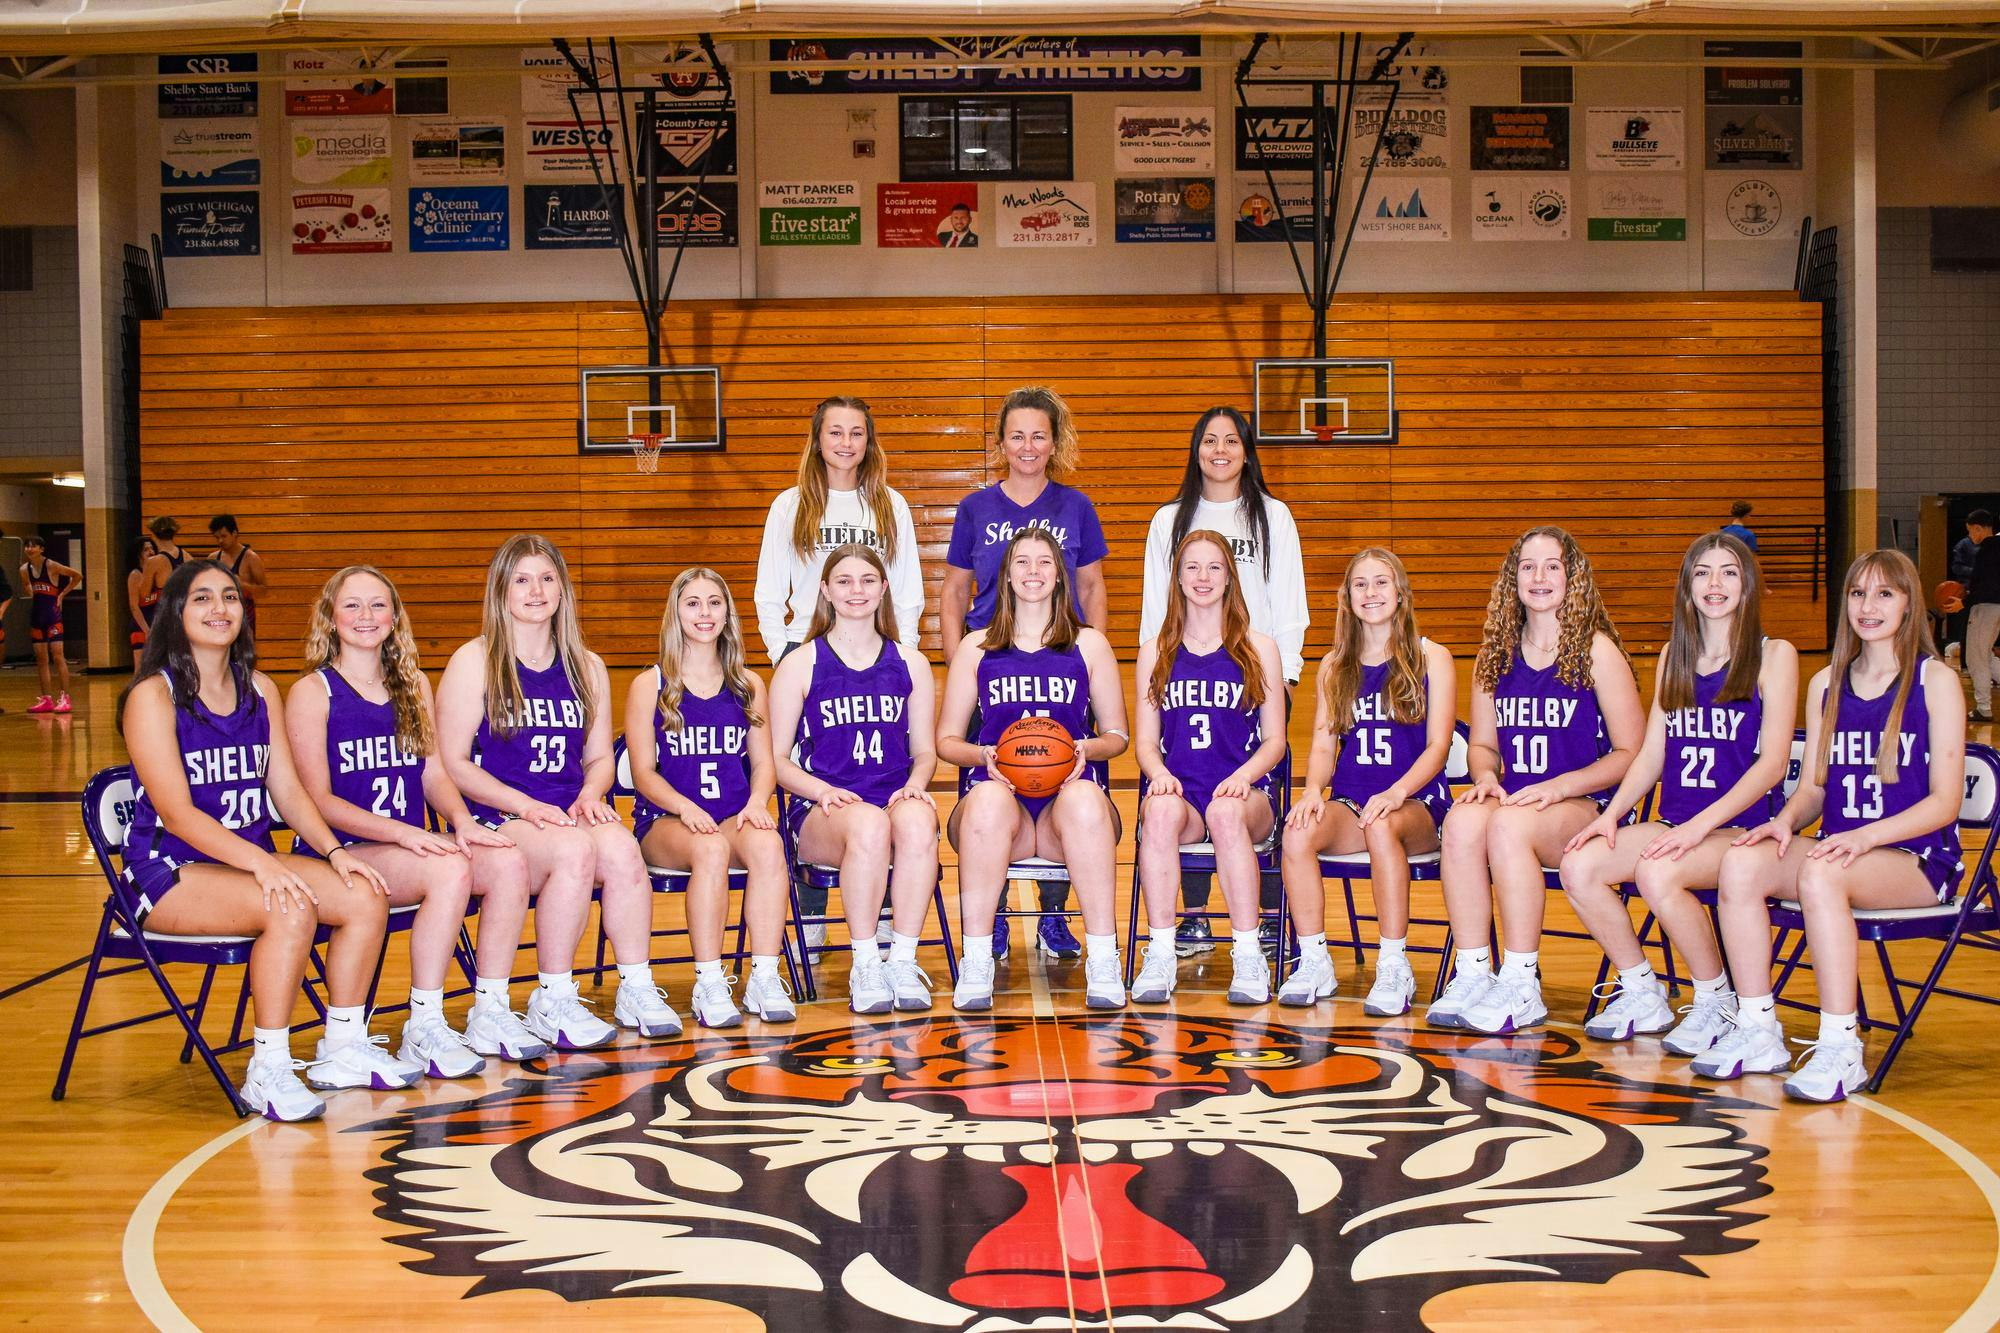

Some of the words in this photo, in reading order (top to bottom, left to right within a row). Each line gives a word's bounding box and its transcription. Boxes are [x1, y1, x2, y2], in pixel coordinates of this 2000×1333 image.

[955, 37, 995, 51] Prud
[999, 36, 1061, 52] Spporters
[293, 60, 325, 70] Klotz
[998, 50, 1184, 79] ATHLETICS
[164, 84, 198, 95] Shelby
[199, 83, 224, 94] State
[226, 83, 251, 93] Bank
[698, 119, 728, 127] Fees
[316, 134, 386, 149] media
[531, 129, 614, 146] WESCO
[1612, 140, 1659, 149] BULLSEYE
[1713, 138, 1756, 152] SILVER
[765, 185, 801, 195] MATT
[803, 184, 854, 195] PARKER
[1135, 190, 1181, 205] Rotary
[1734, 183, 1775, 197] COLBY'S
[167, 202, 194, 215] WEST
[197, 201, 254, 214] MICHIGAN
[430, 198, 480, 210] Oceana
[782, 197, 838, 205] 616.402.7272
[884, 197, 906, 206] Local
[908, 197, 937, 206] service
[1002, 193, 1030, 208] Mac
[437, 210, 504, 222] Veterinary
[884, 206, 892, 215] &
[893, 207, 914, 216] great
[915, 207, 937, 215] rates
[175, 223, 211, 238] Family
[433, 221, 472, 233] Clinic
[656, 213, 722, 232] OBS
[770, 212, 808, 233] five
[1361, 223, 1385, 231] WEST
[1387, 223, 1416, 231] SHORE
[1418, 223, 1442, 231] BANK
[184, 239, 240, 248] 231.861.4858
[770, 233, 789, 241] REAL
[790, 233, 816, 241] ESTATE
[1013, 233, 1080, 242] 231.873.2817
[816, 527, 884, 549] HELB
[988, 675, 1077, 706] SHELBY
[1161, 680, 1245, 711] SHELBY
[819, 694, 905, 729] SHELBY
[1495, 697, 1578, 728] SHELBY
[1009, 719, 1062, 735] Rawlings
[1188, 713, 1212, 750] 3
[664, 725, 746, 757] SHELBY
[852, 729, 884, 766] 44
[1355, 728, 1392, 766] 15
[1829, 731, 1917, 767] HELY
[338, 735, 418, 774] SHELB
[529, 735, 567, 774] 33
[1512, 734, 1548, 774] 10
[1680, 746, 1716, 788] 22
[699, 762, 721, 800] 5
[371, 775, 407, 818] 24
[1841, 774, 1884, 819] 13
[220, 788, 261, 830] 20
